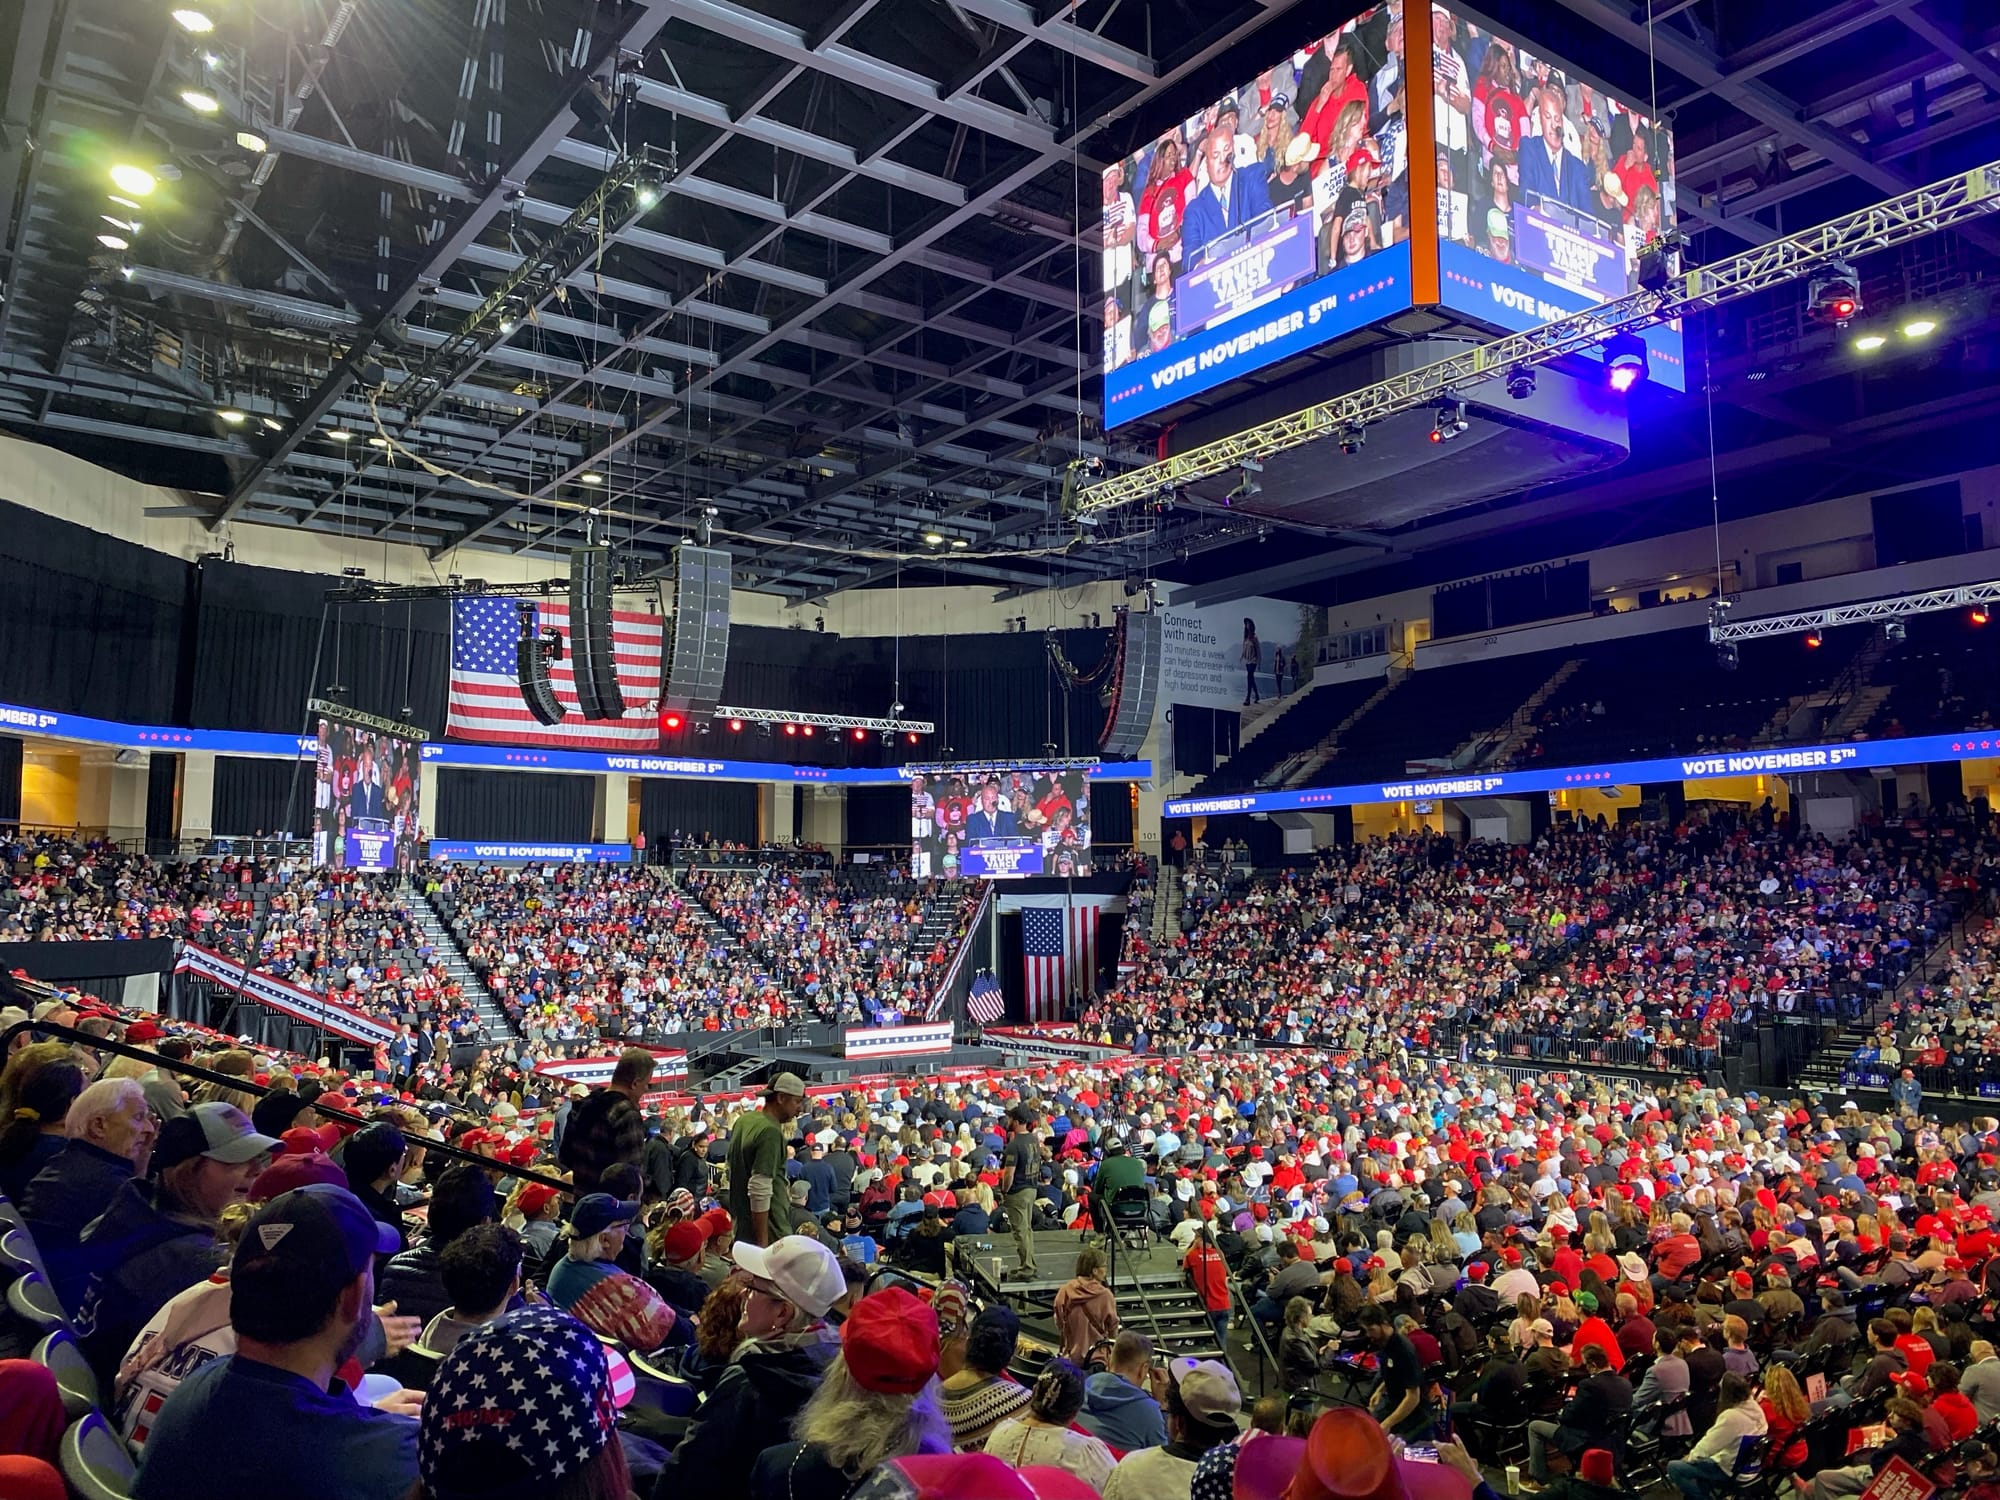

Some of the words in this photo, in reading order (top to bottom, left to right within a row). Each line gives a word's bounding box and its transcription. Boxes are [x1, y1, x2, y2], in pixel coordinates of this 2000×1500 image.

[1491, 282, 1535, 316] VOTE
[1151, 356, 1196, 389] VOTE
[1199, 311, 1304, 370] NOVEMBER
[1308, 294, 1337, 324] 5TH
[1164, 612, 1202, 630] Connect
[1164, 627, 1184, 640] with
[1187, 632, 1216, 645] nature
[1484, 637, 1498, 646] 202
[1164, 643, 1173, 653] 30
[1175, 646, 1200, 657] minutes
[1164, 657, 1176, 665] can
[1178, 656, 1192, 669] help
[0, 708, 37, 727] MBER
[39, 715, 58, 728] 5TH
[297, 738, 318, 751] VO
[422, 746, 443, 758] 5TH
[607, 757, 640, 769] VOTE
[641, 759, 706, 773] NOVEMBER
[708, 763, 724, 773] 5TH
[1682, 759, 1726, 775] VOTE
[1729, 751, 1827, 772] NOVEMBER
[1830, 748, 1856, 764] 5TH
[1382, 785, 1413, 798] VOTE
[1415, 779, 1482, 796] NOVEMBER
[1484, 778, 1503, 791] 5TH
[1168, 803, 1192, 815] VOTE
[1192, 800, 1241, 813] NOVEMBER
[1242, 798, 1256, 809] 5TH
[778, 834, 791, 842] 122
[1143, 832, 1156, 840] 101
[360, 840, 383, 850] TRUMP
[474, 846, 507, 856] VOTE
[509, 847, 574, 858] NOVEMBER
[576, 848, 592, 858] 5TH
[982, 853, 1021, 863] TRUMP
[1872, 1470, 1897, 1498] MAKE
[1879, 1471, 1911, 1500] MERICA
